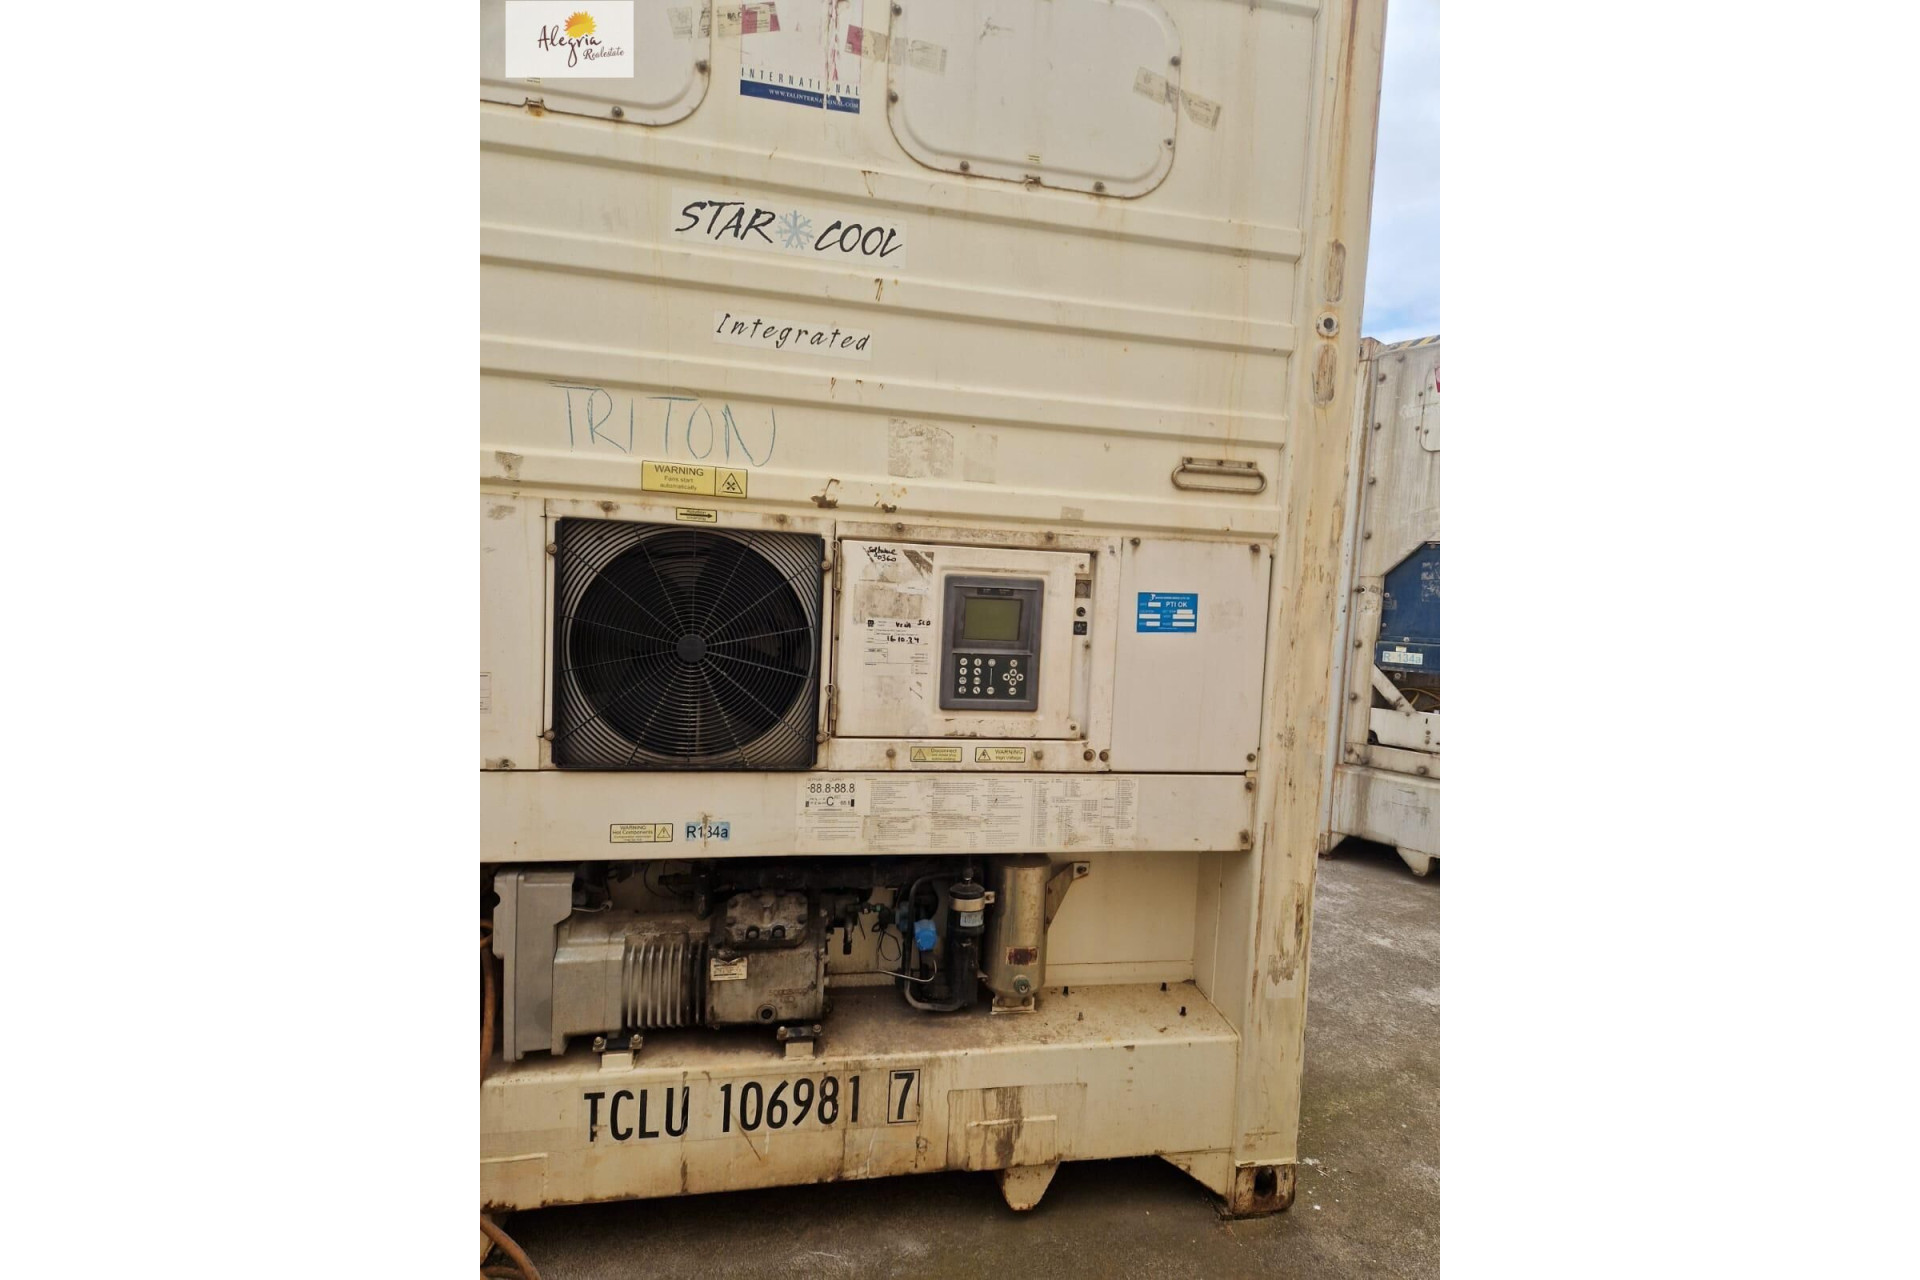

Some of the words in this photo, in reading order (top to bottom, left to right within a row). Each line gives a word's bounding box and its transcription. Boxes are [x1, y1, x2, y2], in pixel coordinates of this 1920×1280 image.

[741, 67, 860, 96] INTERNATINAL
[674, 200, 776, 244] STAR
[814, 220, 903, 258] COOL
[715, 312, 871, 352] Integrated
[551, 382, 777, 467] TRITON
[654, 464, 704, 477] WARNING
[1383, 652, 1391, 660] R
[584, 1086, 690, 1142] TCLU
[720, 1075, 860, 1132] 106981
[893, 1072, 915, 1120] 7
